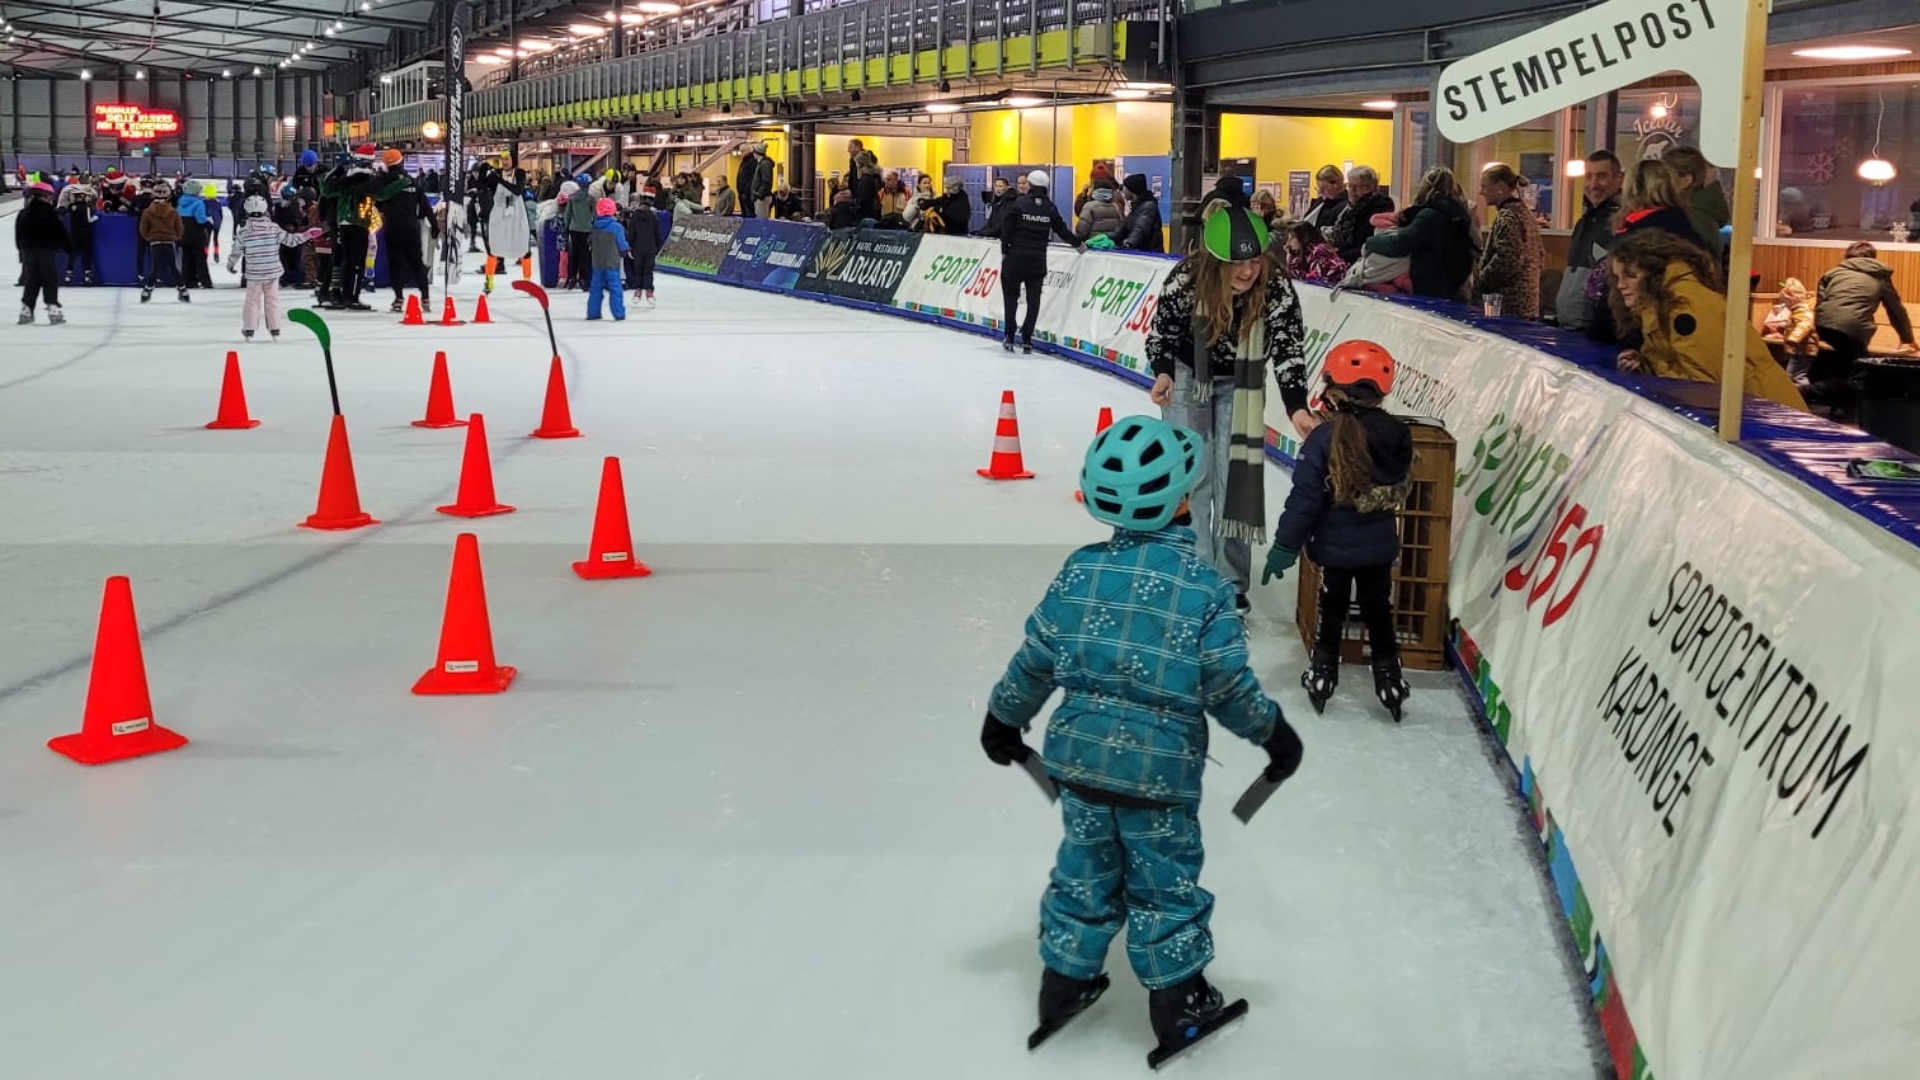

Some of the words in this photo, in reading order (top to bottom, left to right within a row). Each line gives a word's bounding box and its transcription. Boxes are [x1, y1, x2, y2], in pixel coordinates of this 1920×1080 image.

[1443, 0, 1716, 121] STEMPELPOST
[838, 254, 903, 289] ADUARD
[924, 254, 980, 286] SPORT
[1081, 275, 1145, 318] SPORT
[1648, 561, 1870, 839] SPORTCENTRUM
[1597, 645, 1716, 839] KARDINGE
